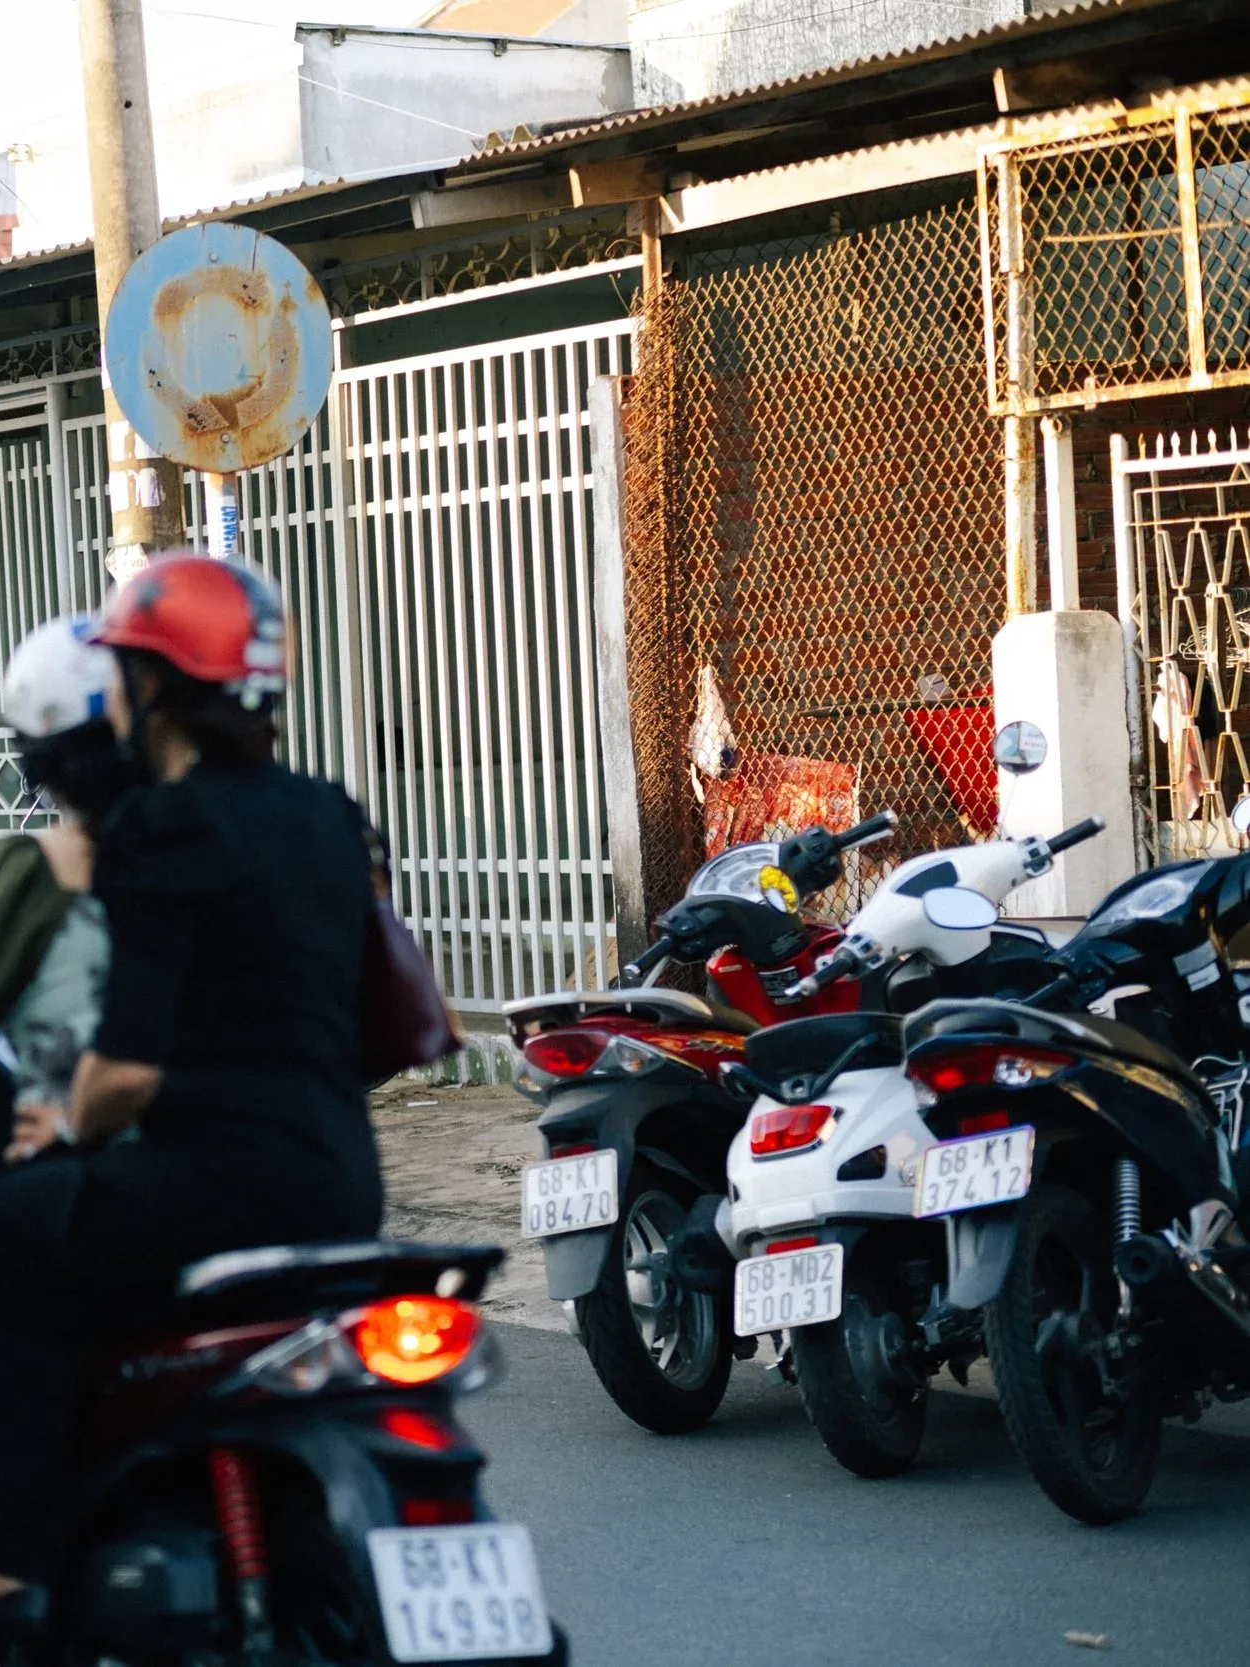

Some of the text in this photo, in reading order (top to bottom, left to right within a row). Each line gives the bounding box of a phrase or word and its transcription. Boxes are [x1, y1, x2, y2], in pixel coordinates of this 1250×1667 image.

[538, 1157, 599, 1196] 68-K1
[938, 1136, 1013, 1177] 68-K1
[925, 1166, 1022, 1211] 374.12
[530, 1191, 611, 1232] 084.70
[742, 1284, 834, 1328] 500.31
[400, 1536, 508, 1591] 68-K1
[401, 1595, 540, 1652] 149.98
